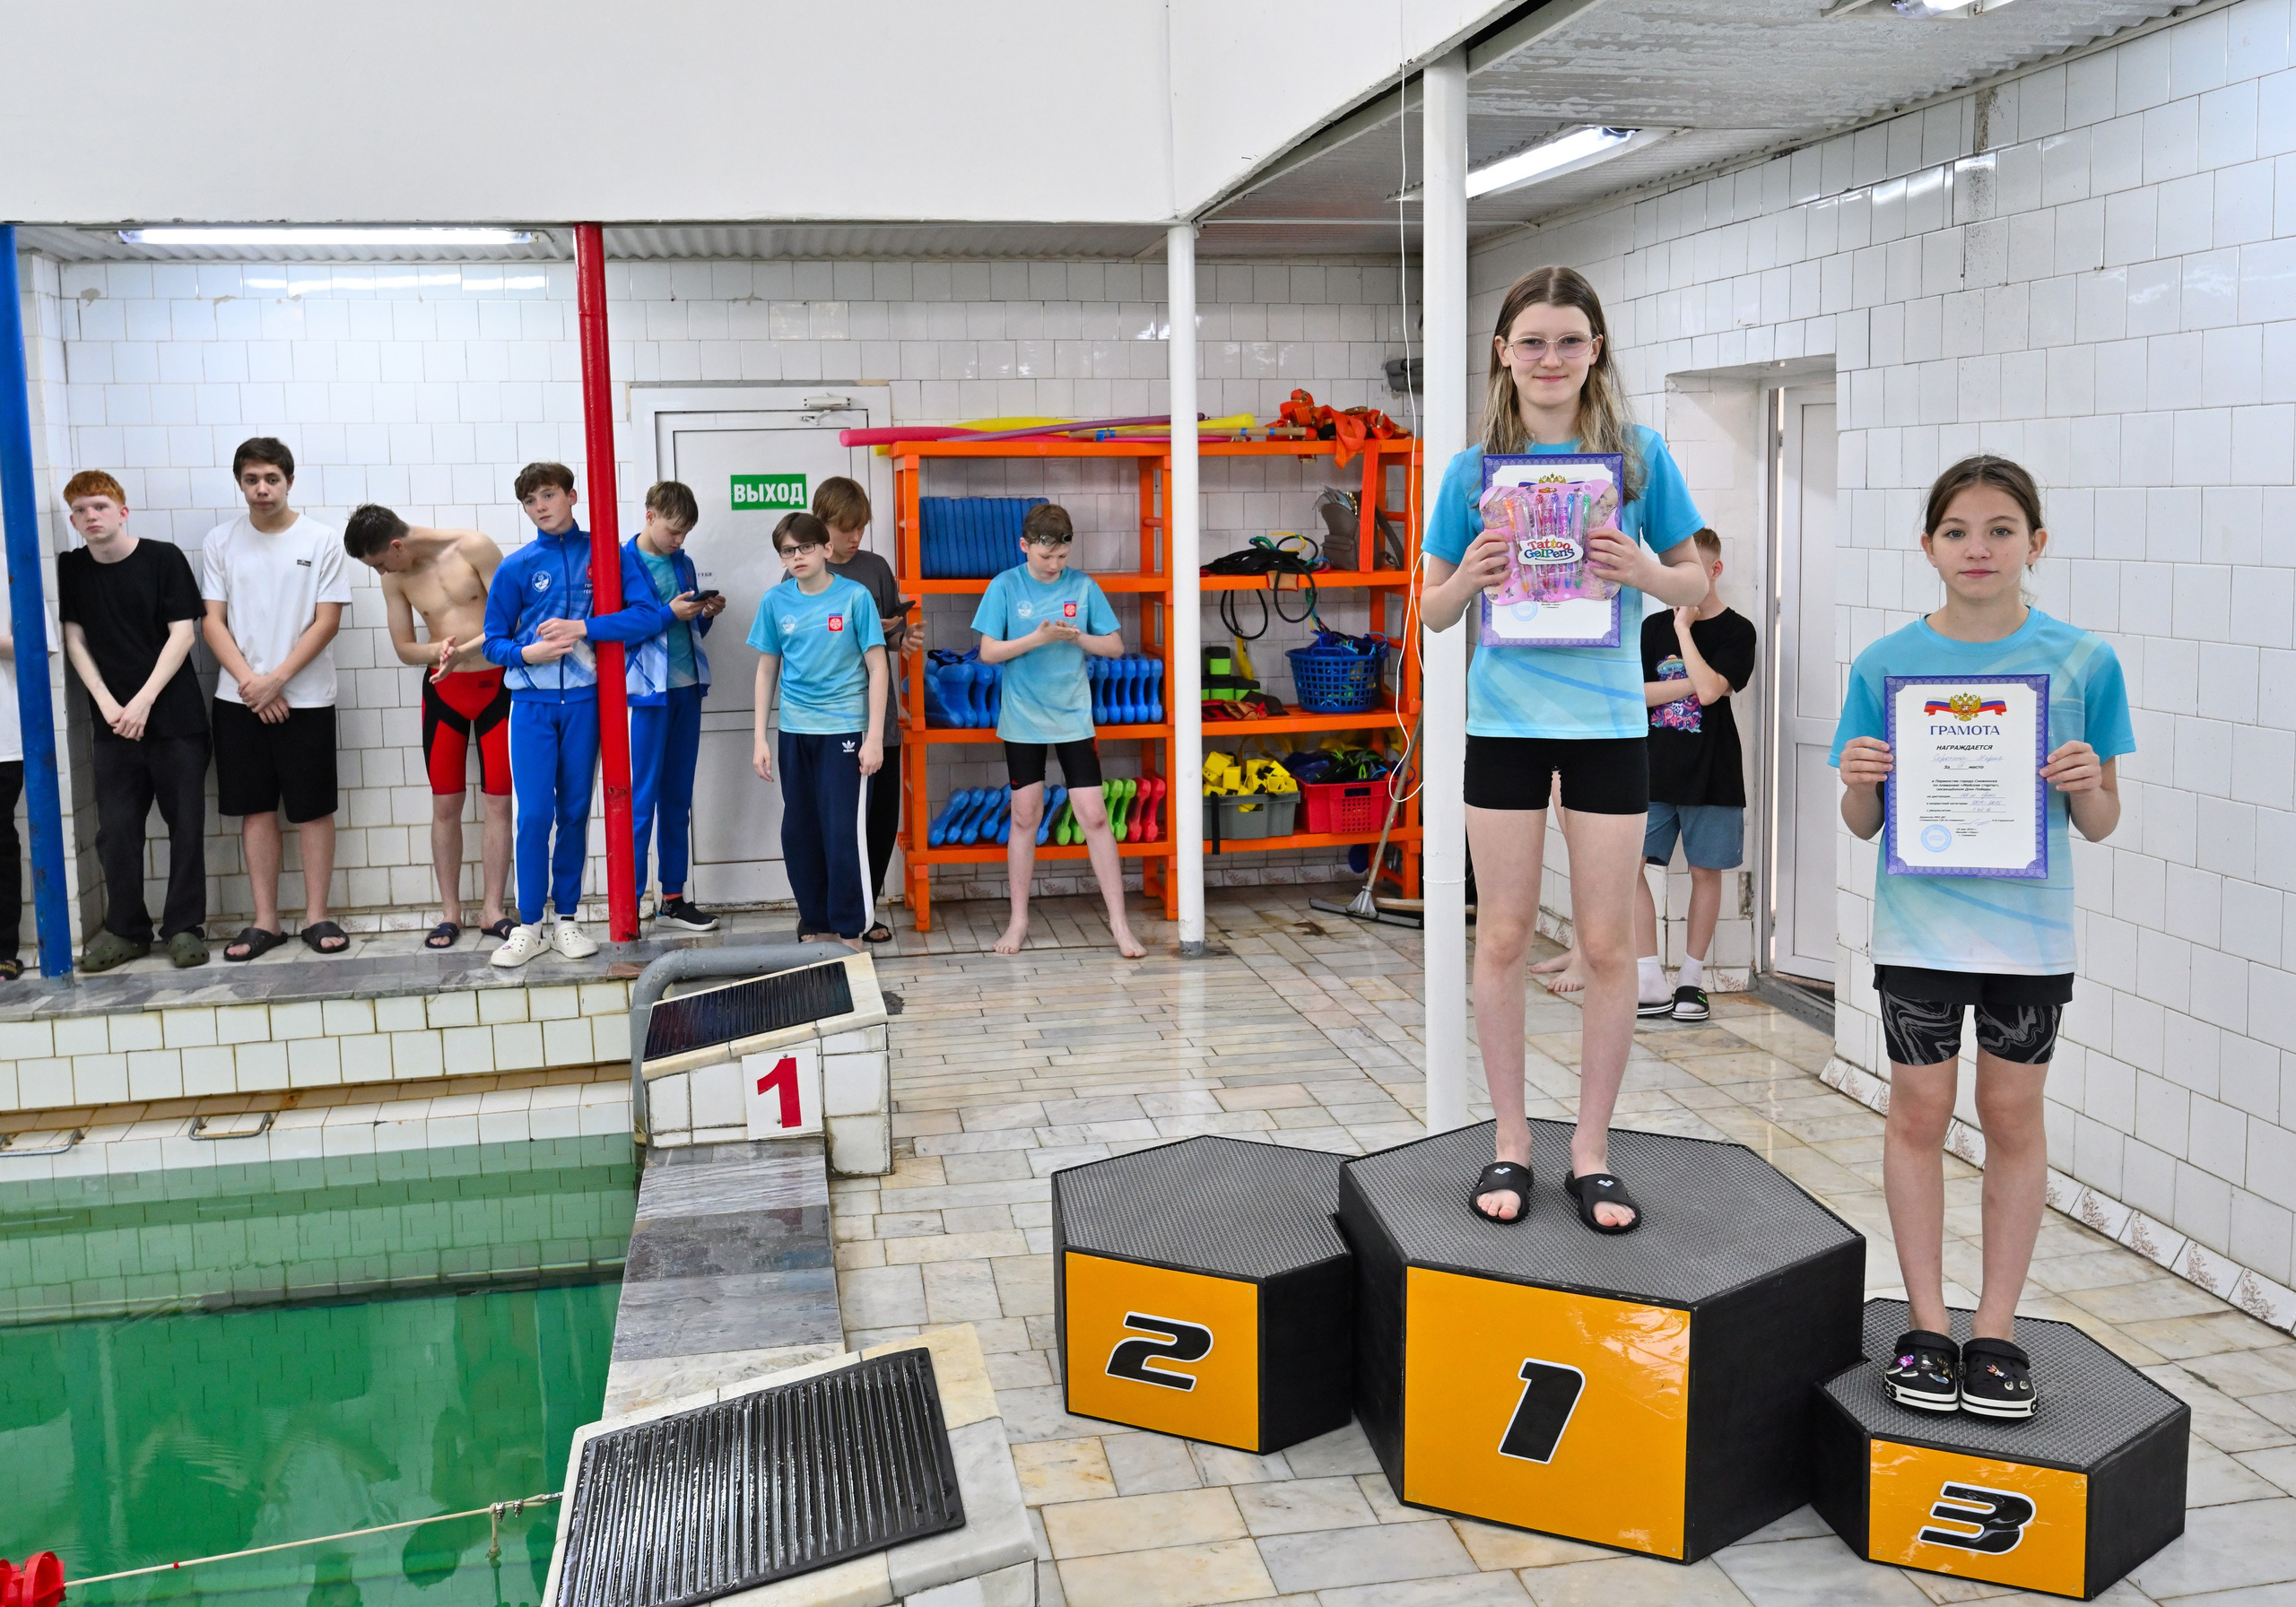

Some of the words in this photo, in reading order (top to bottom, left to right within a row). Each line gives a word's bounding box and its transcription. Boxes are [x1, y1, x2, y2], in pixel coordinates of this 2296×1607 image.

[734, 483, 804, 505] ВЫХОД
[1526, 538, 1570, 551] Tattoo
[1930, 725, 2000, 735] ГРАМОТА
[756, 1056, 802, 1128] 1
[1105, 1311, 1214, 1392] 2
[1497, 1358, 1586, 1464] 1
[1918, 1481, 2037, 1555] 3
